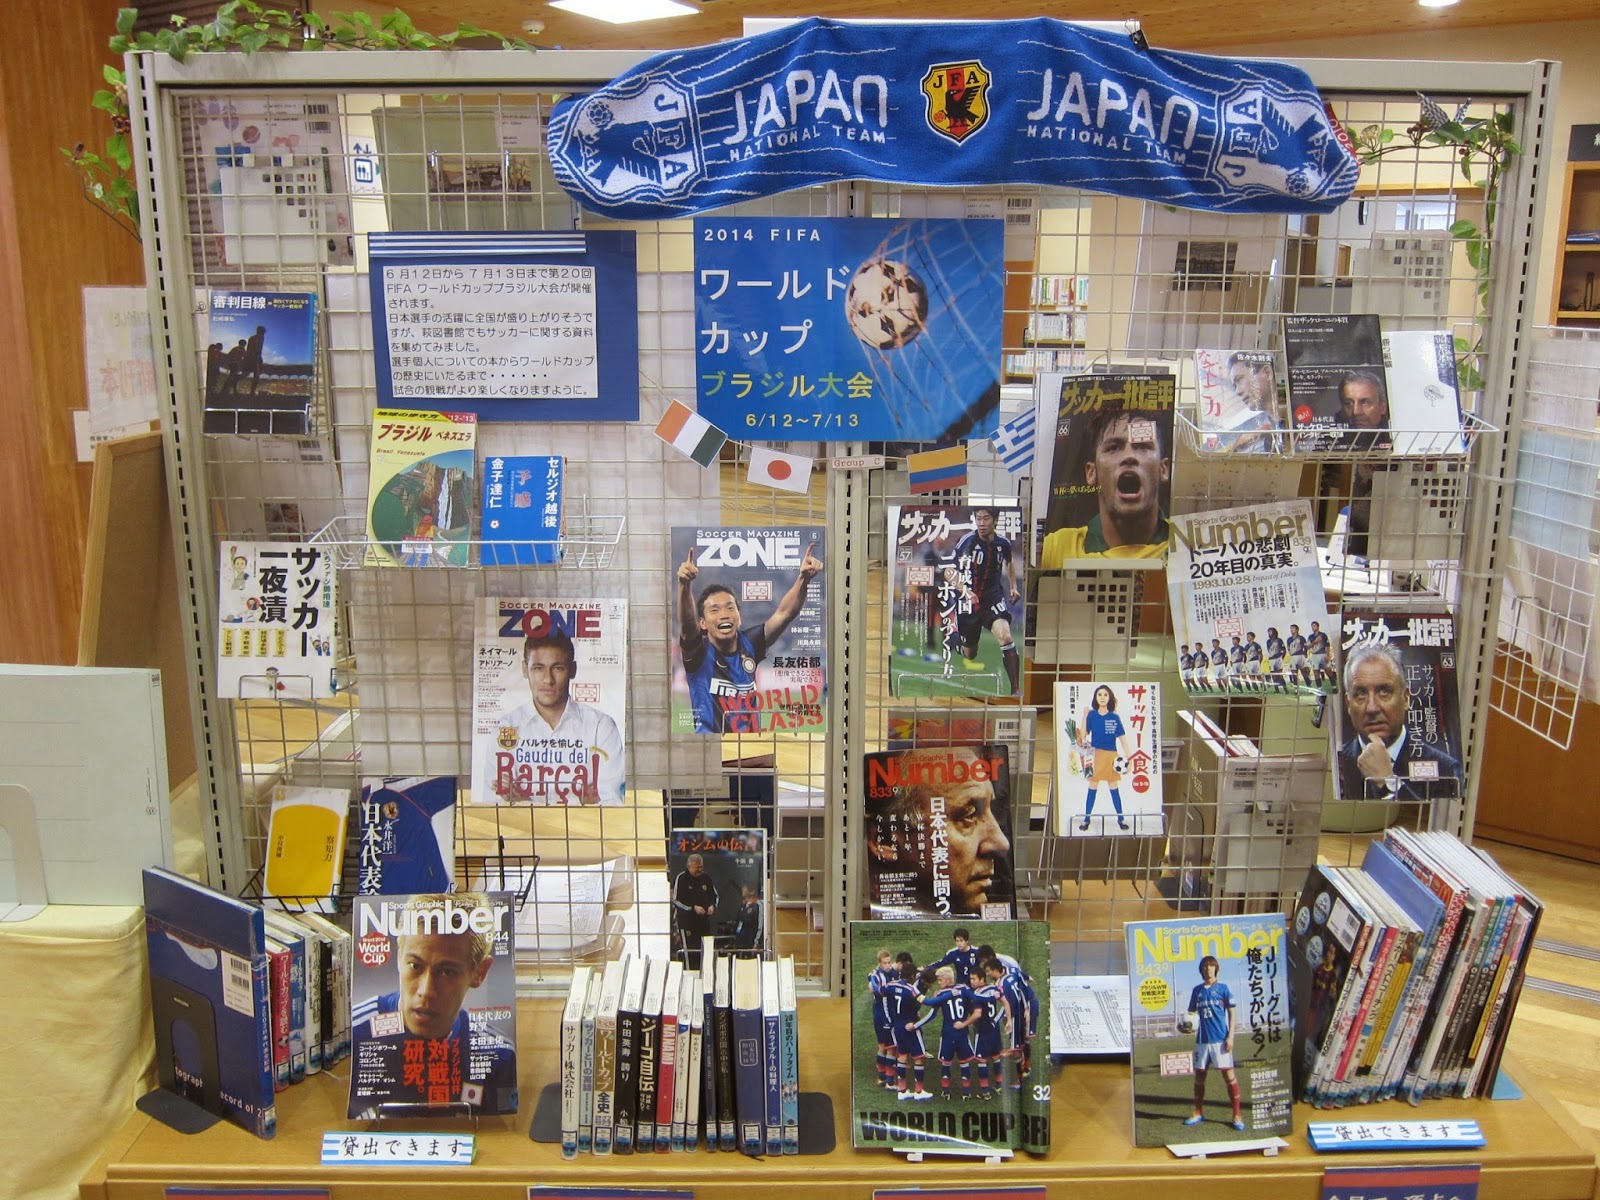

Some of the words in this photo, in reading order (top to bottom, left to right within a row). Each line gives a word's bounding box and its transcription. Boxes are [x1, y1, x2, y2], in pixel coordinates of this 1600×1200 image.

[933, 71, 980, 88] JFA
[724, 69, 888, 146] JAPAN
[1027, 69, 1200, 149] JAPAN
[730, 124, 822, 162] NATIONAL
[836, 125, 887, 145] TEAM
[1028, 125, 1130, 153] NATIONAL
[1144, 142, 1187, 165] TEAM
[704, 229, 754, 241] 2014
[770, 229, 821, 241] FIFA
[387, 284, 412, 294] FIFA
[700, 265, 849, 301] ワールド
[213, 295, 266, 310] 審判目線
[388, 298, 436, 309] されます。
[389, 312, 593, 324] 日本選手の活躍に全国が盛り上がりそうで
[390, 327, 593, 338] すが、萩図書館でもサッカーに関する資料
[700, 318, 813, 356] カップ
[391, 342, 481, 353] を集めてみました。
[1237, 354, 1272, 362] 佐々木則夫
[1382, 339, 1392, 368] 勝つ組織
[392, 356, 594, 367] 選手個人についての本からワールドカップ
[394, 385, 589, 396] 試合の観戦がより楽しくなりますように。
[701, 370, 873, 399] ブラジル大会
[1059, 380, 1174, 418] サッカー批評
[377, 411, 440, 419] 地球の歩き方
[378, 424, 432, 442] ブラジル
[436, 432, 472, 441] ベネズエラ
[1058, 425, 1068, 435] 66
[833, 459, 865, 467] Group
[874, 458, 881, 466] C
[489, 457, 504, 509] 金子達仁
[544, 456, 560, 528] セルジオ越後
[898, 510, 1021, 545] サッカー評
[1169, 511, 1307, 553] Number
[1194, 517, 1219, 527] Sports
[1219, 513, 1248, 523] Graphic
[697, 530, 742, 538] SOCCER
[747, 530, 800, 538] MAGAZINE
[1293, 537, 1311, 547] 839
[696, 537, 801, 567] ZONE
[900, 551, 911, 561] 57
[972, 550, 984, 565] 10
[1190, 534, 1291, 562] ドーハの悲劇
[1189, 553, 1298, 579] 20年目の真実。
[258, 551, 289, 623] 一夜漬
[958, 554, 973, 615] 育成大国
[1193, 575, 1250, 590] 1993.10.28
[1252, 574, 1270, 582] Impact
[291, 548, 321, 657] サッカー
[499, 601, 544, 609] SOCCER
[937, 550, 957, 679] ニッポンのつくり方
[498, 609, 601, 638] ZONE
[1342, 617, 1453, 650] サッカー批評
[479, 647, 517, 656] ネイマール
[773, 657, 820, 668] 長友佑都
[1442, 658, 1454, 667] 63
[719, 684, 818, 716] WORLD
[1406, 664, 1424, 757] 正しい叩き方
[1422, 664, 1438, 744] サッカー監督の
[731, 711, 824, 733] CLASS
[1127, 685, 1152, 775] サッカー食
[516, 749, 558, 764] Gaudiu
[570, 748, 588, 764] del
[521, 739, 583, 748] バルサを愉しむ
[868, 753, 1003, 788] Number
[919, 754, 946, 762] Graphic
[869, 787, 892, 798] 833
[325, 835, 335, 862] 察知力
[360, 803, 383, 895] 日本代表
[382, 820, 393, 855] 永井洋一
[876, 814, 886, 862] 今しかない。
[890, 813, 898, 861] 変わるなら
[916, 814, 926, 869] W杯決勝まで
[930, 797, 952, 917] 日本代表に問う。
[360, 899, 509, 937] Number
[389, 901, 414, 910] Sports
[416, 900, 445, 909] Graphic
[485, 931, 509, 943] 844
[1162, 926, 1190, 935] Sports
[1190, 924, 1221, 934] Graphic
[358, 942, 390, 953] World
[1134, 923, 1284, 964] Number
[363, 953, 385, 964] Cup
[1136, 963, 1162, 976] 843
[280, 956, 289, 1034] ワールドカップを読む
[895, 996, 902, 1014] 7
[1246, 947, 1267, 1058] 俺たちがいる！
[1266, 945, 1282, 1043] Jリーグには
[469, 1011, 511, 1021] 日本代表の
[947, 998, 965, 1020] 16
[469, 1022, 487, 1031] 野望
[622, 1019, 632, 1056] 中田英寿
[470, 1036, 504, 1045] 本田圭佑
[662, 1024, 676, 1065] NANAMI
[403, 1040, 425, 1093] 研究。
[564, 1026, 575, 1098] サッカー株式会社
[597, 1030, 613, 1090] ワールドカップ
[640, 1017, 656, 1092] ジーコ自伝
[768, 1021, 777, 1092] サムライブルーの料理人
[428, 1039, 449, 1108] 対戦国
[620, 1063, 630, 1081] 誇り
[597, 1092, 610, 1113] 全史
[1033, 1085, 1050, 1101] 32
[859, 1110, 956, 1141] WORLD
[962, 1111, 1016, 1143] CUP
[1334, 1124, 1452, 1141] 貸出できます
[340, 1134, 464, 1158] 貸出できます
